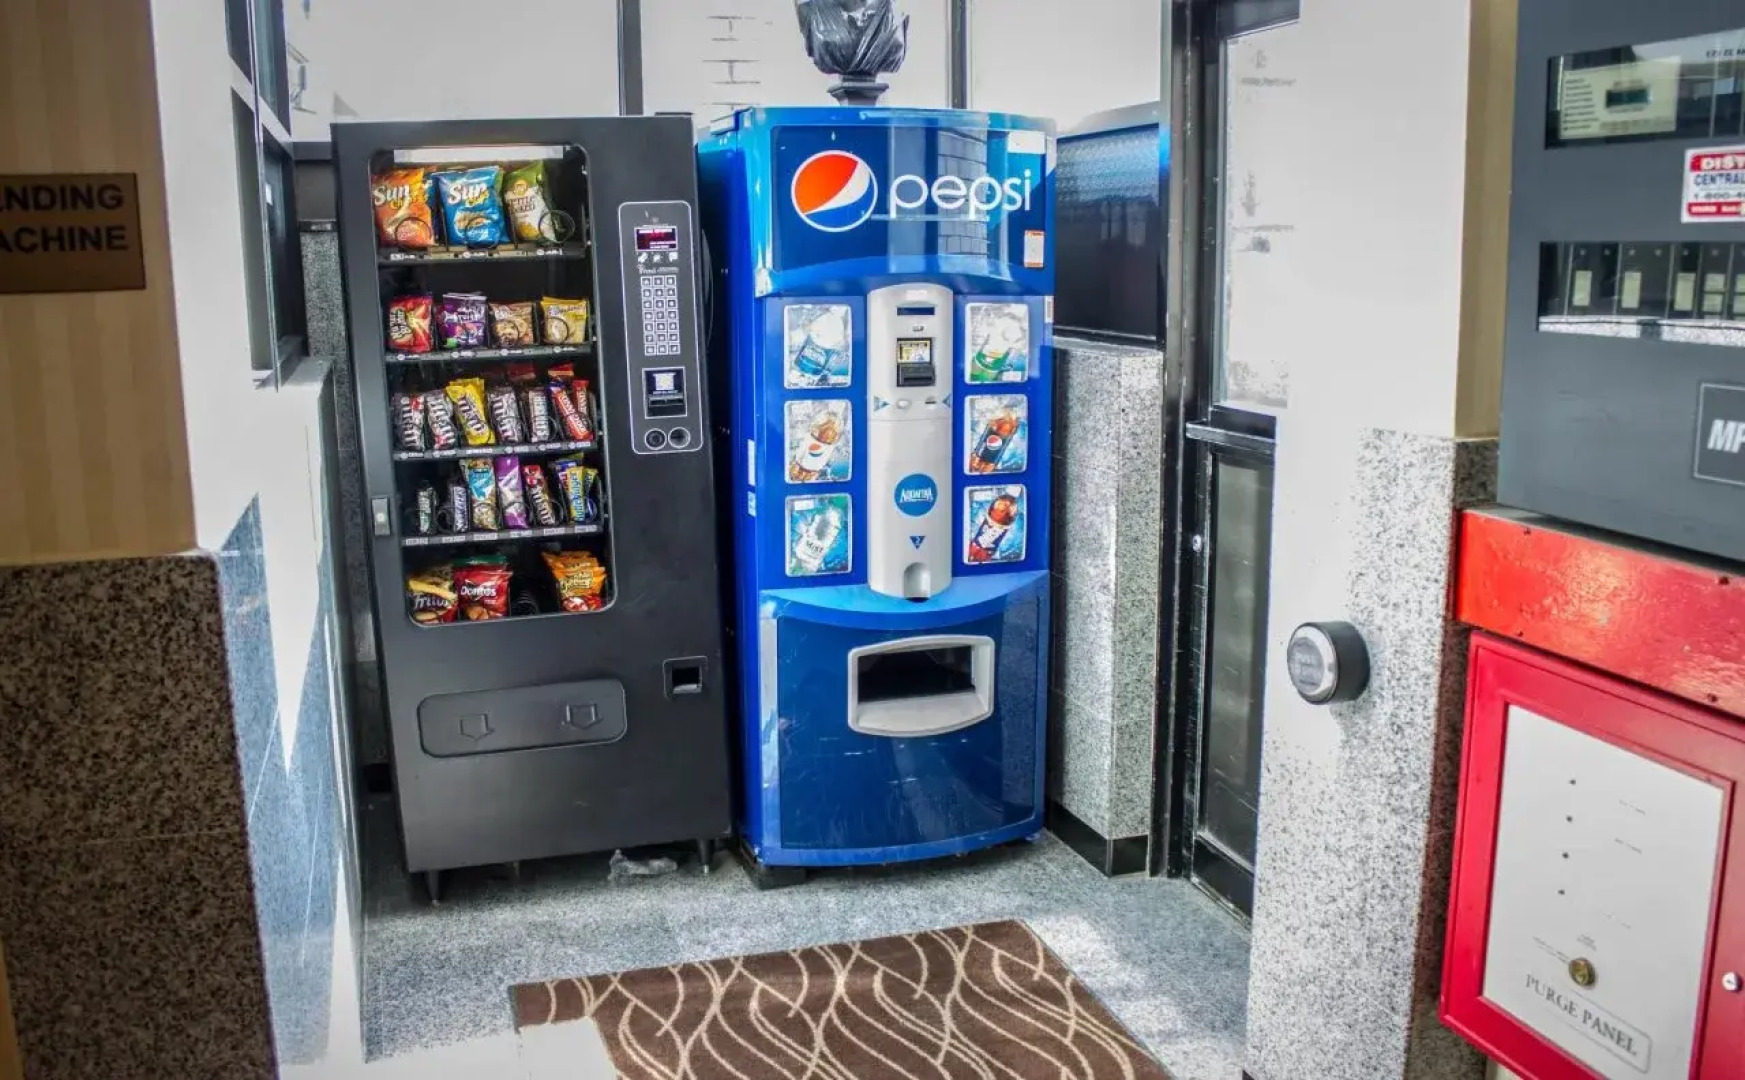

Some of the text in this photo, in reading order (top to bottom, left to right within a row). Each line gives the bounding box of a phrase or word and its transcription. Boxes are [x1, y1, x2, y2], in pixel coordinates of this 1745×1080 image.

[0, 183, 124, 212] NDING
[373, 184, 410, 206] Sun
[447, 182, 487, 204] Sun
[889, 168, 1031, 219] pepsi
[460, 582, 498, 598] Doritos
[1525, 973, 1637, 1056] PURGE PANEL
